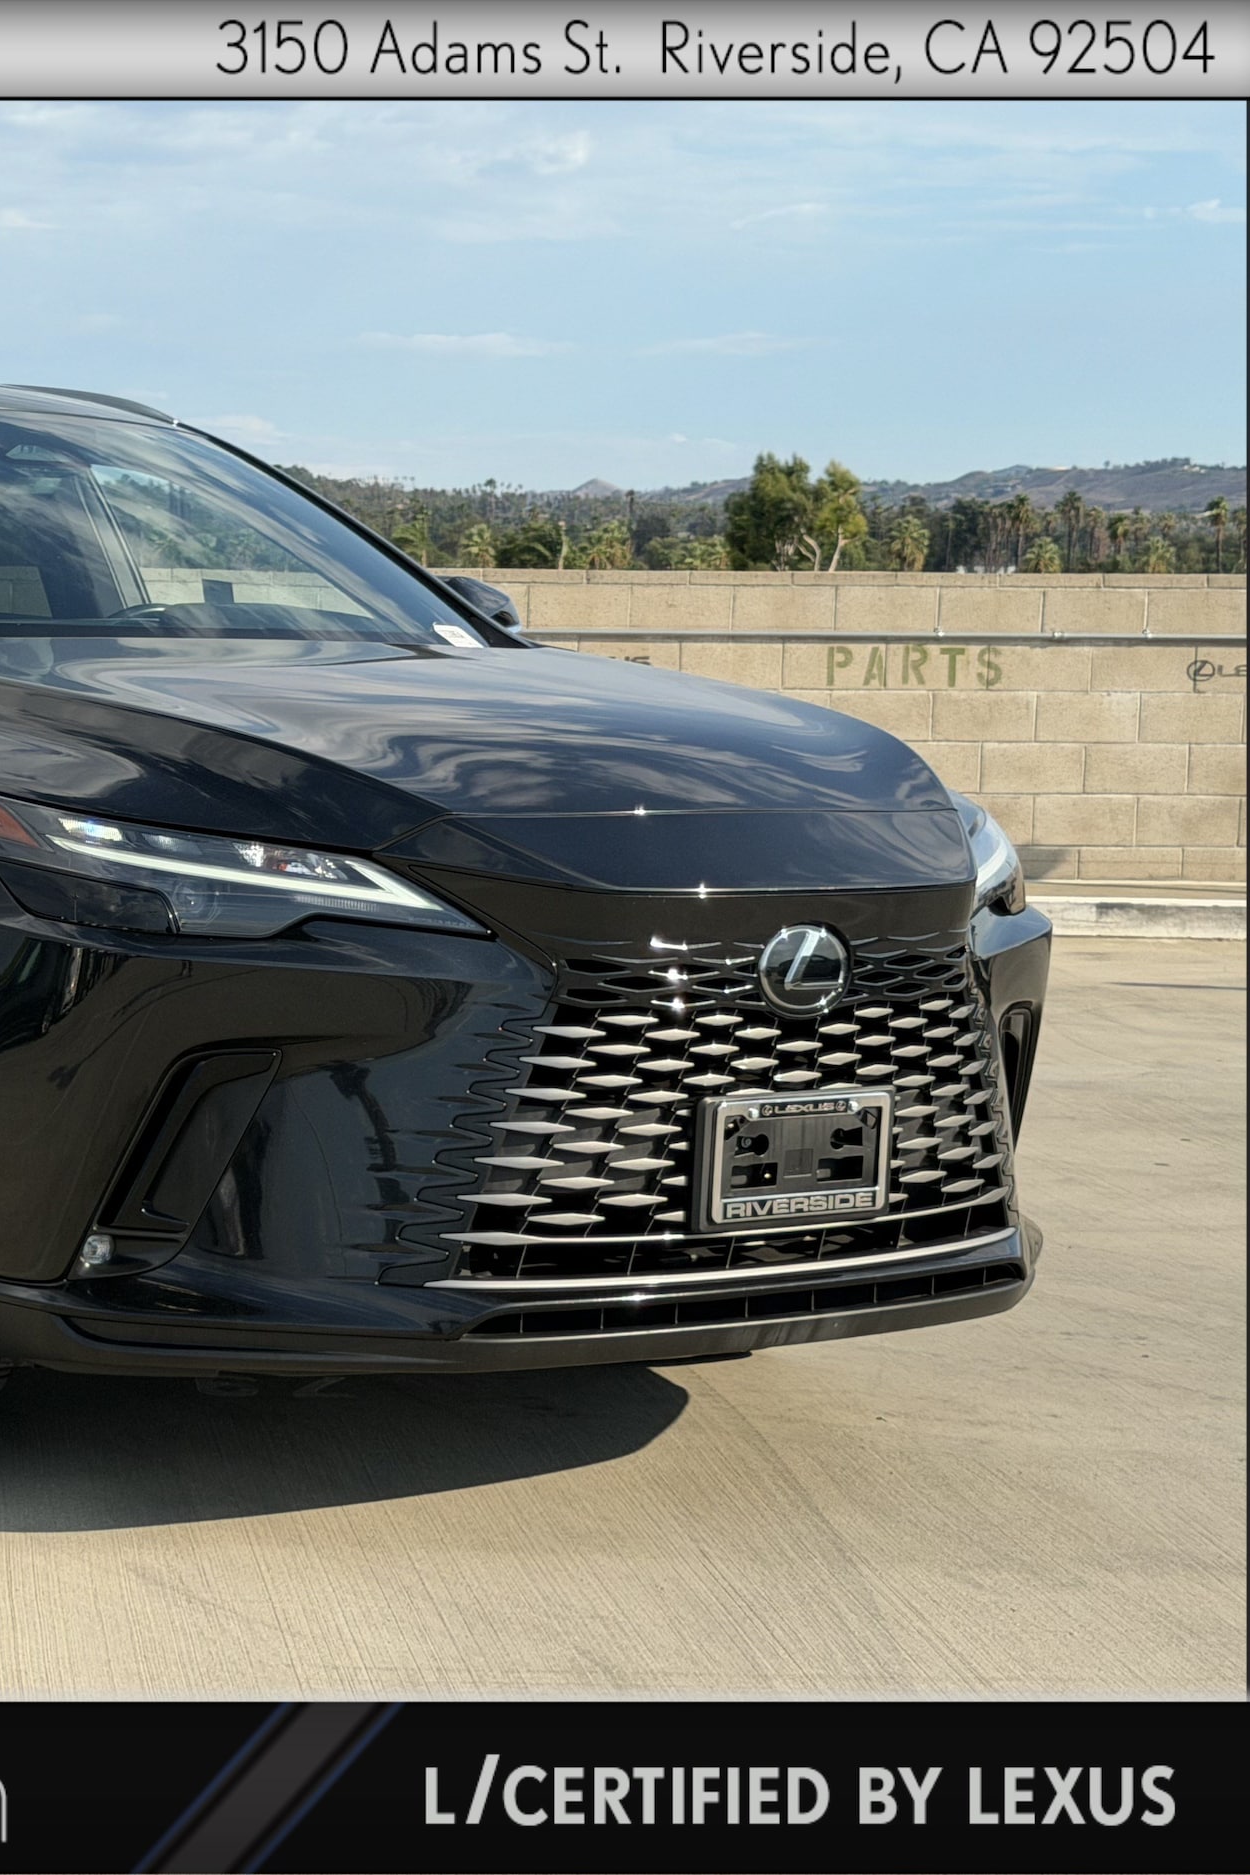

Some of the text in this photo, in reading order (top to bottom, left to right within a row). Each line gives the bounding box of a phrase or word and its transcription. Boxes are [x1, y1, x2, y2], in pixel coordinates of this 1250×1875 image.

[825, 642, 1003, 689] PARTS
[773, 1100, 835, 1115] LEXUS
[725, 1191, 874, 1219] RIVERSIDE
